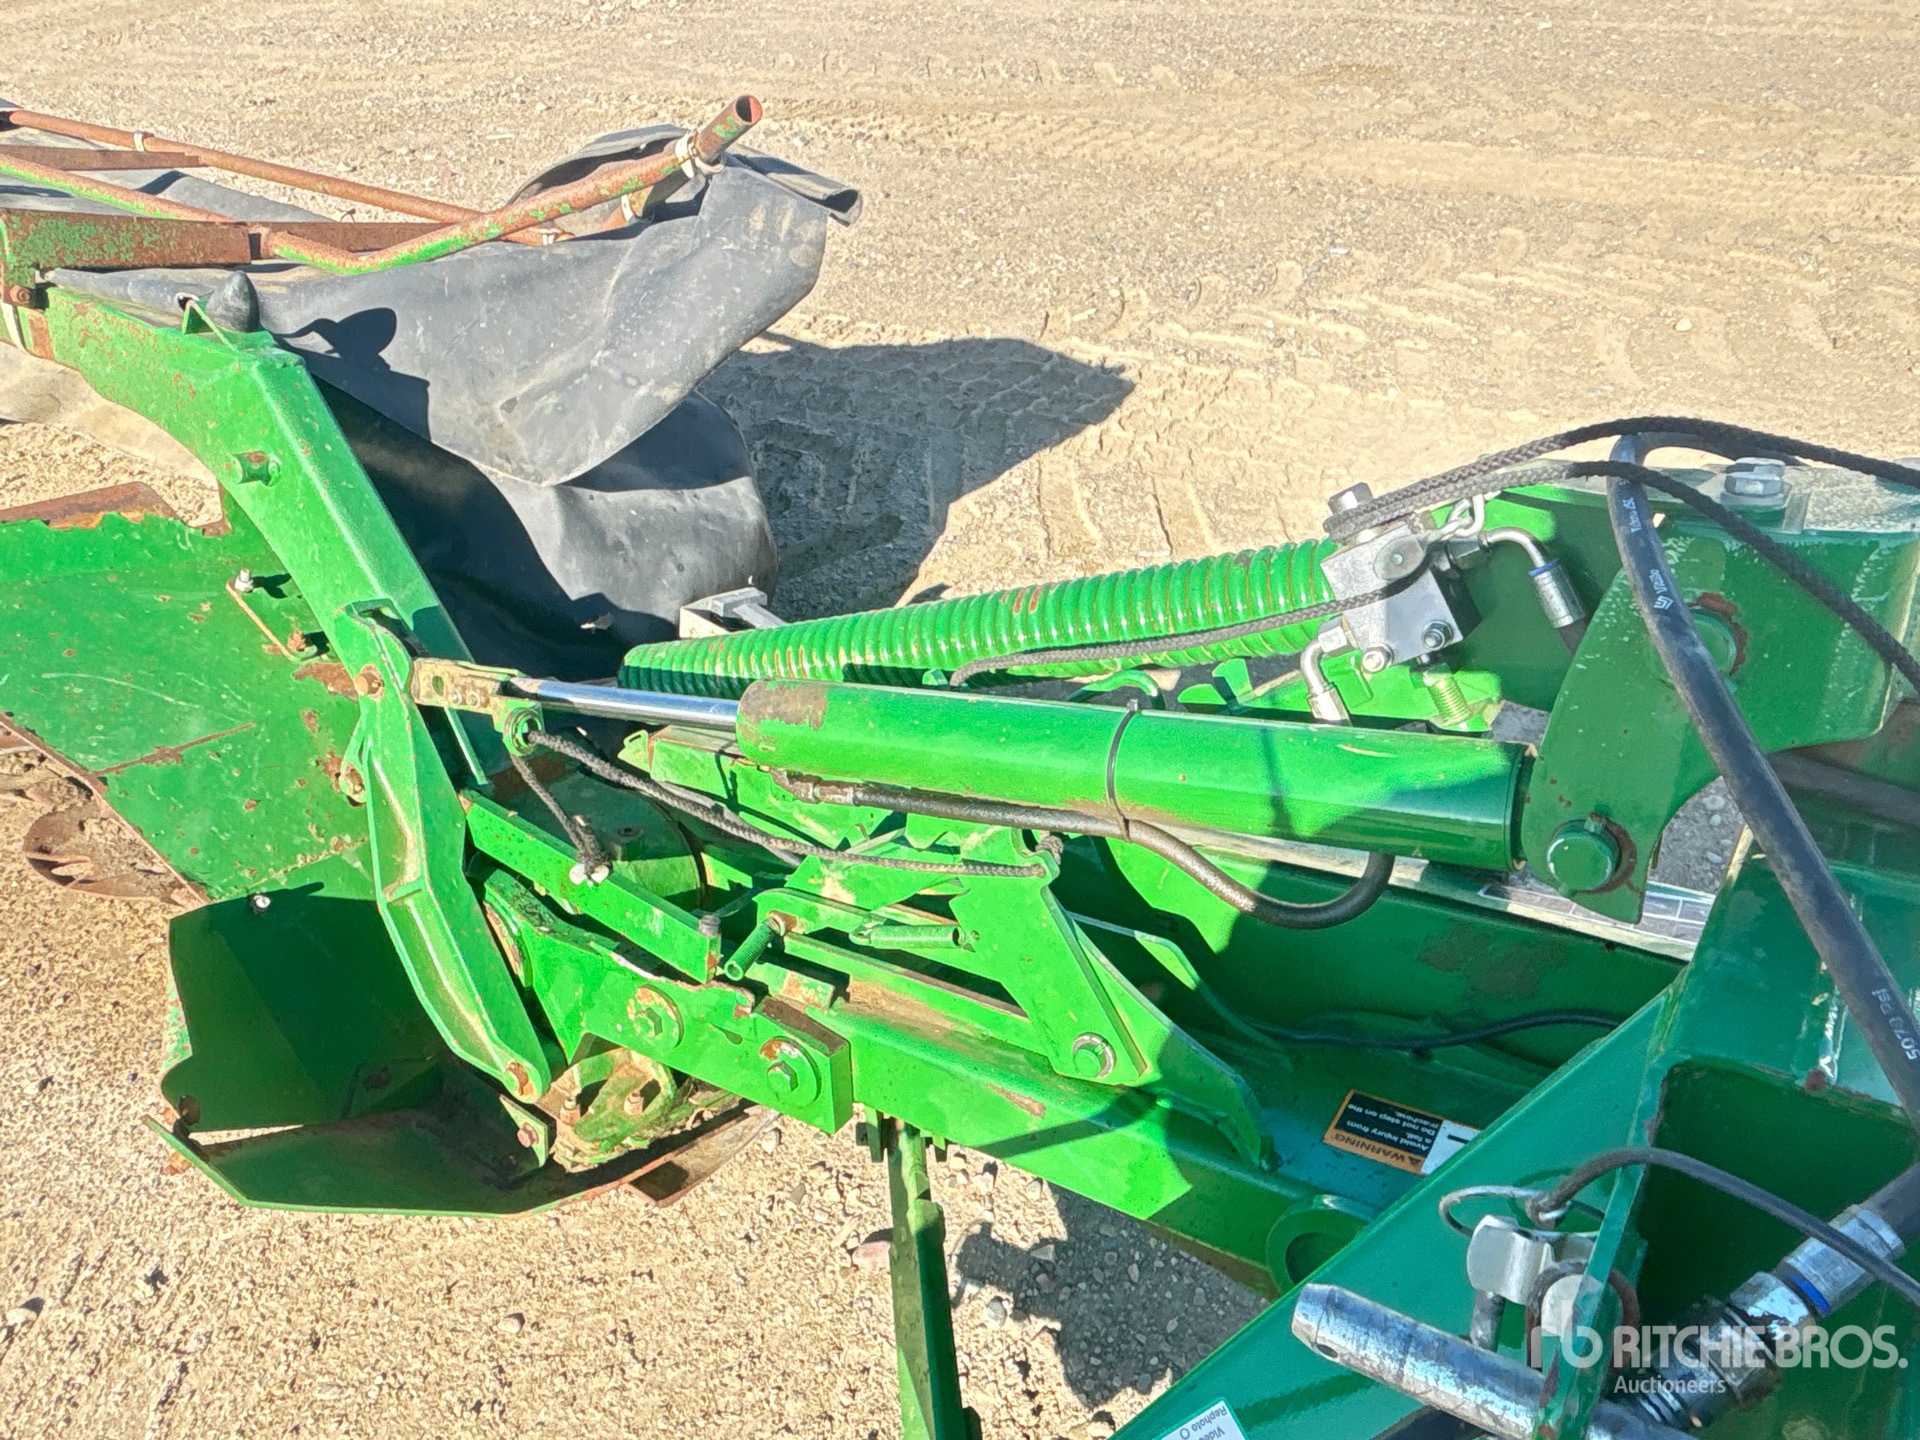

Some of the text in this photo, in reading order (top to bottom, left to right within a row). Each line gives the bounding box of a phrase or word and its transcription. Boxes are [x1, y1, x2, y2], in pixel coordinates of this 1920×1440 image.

[1348, 1104, 1436, 1136] Do not step on the
[1334, 1132, 1405, 1162] WARNING
[1347, 1121, 1430, 1152] Avoid injury from
[1405, 1132, 1422, 1142] fall.
[1191, 1405, 1228, 1431] Rephoto
